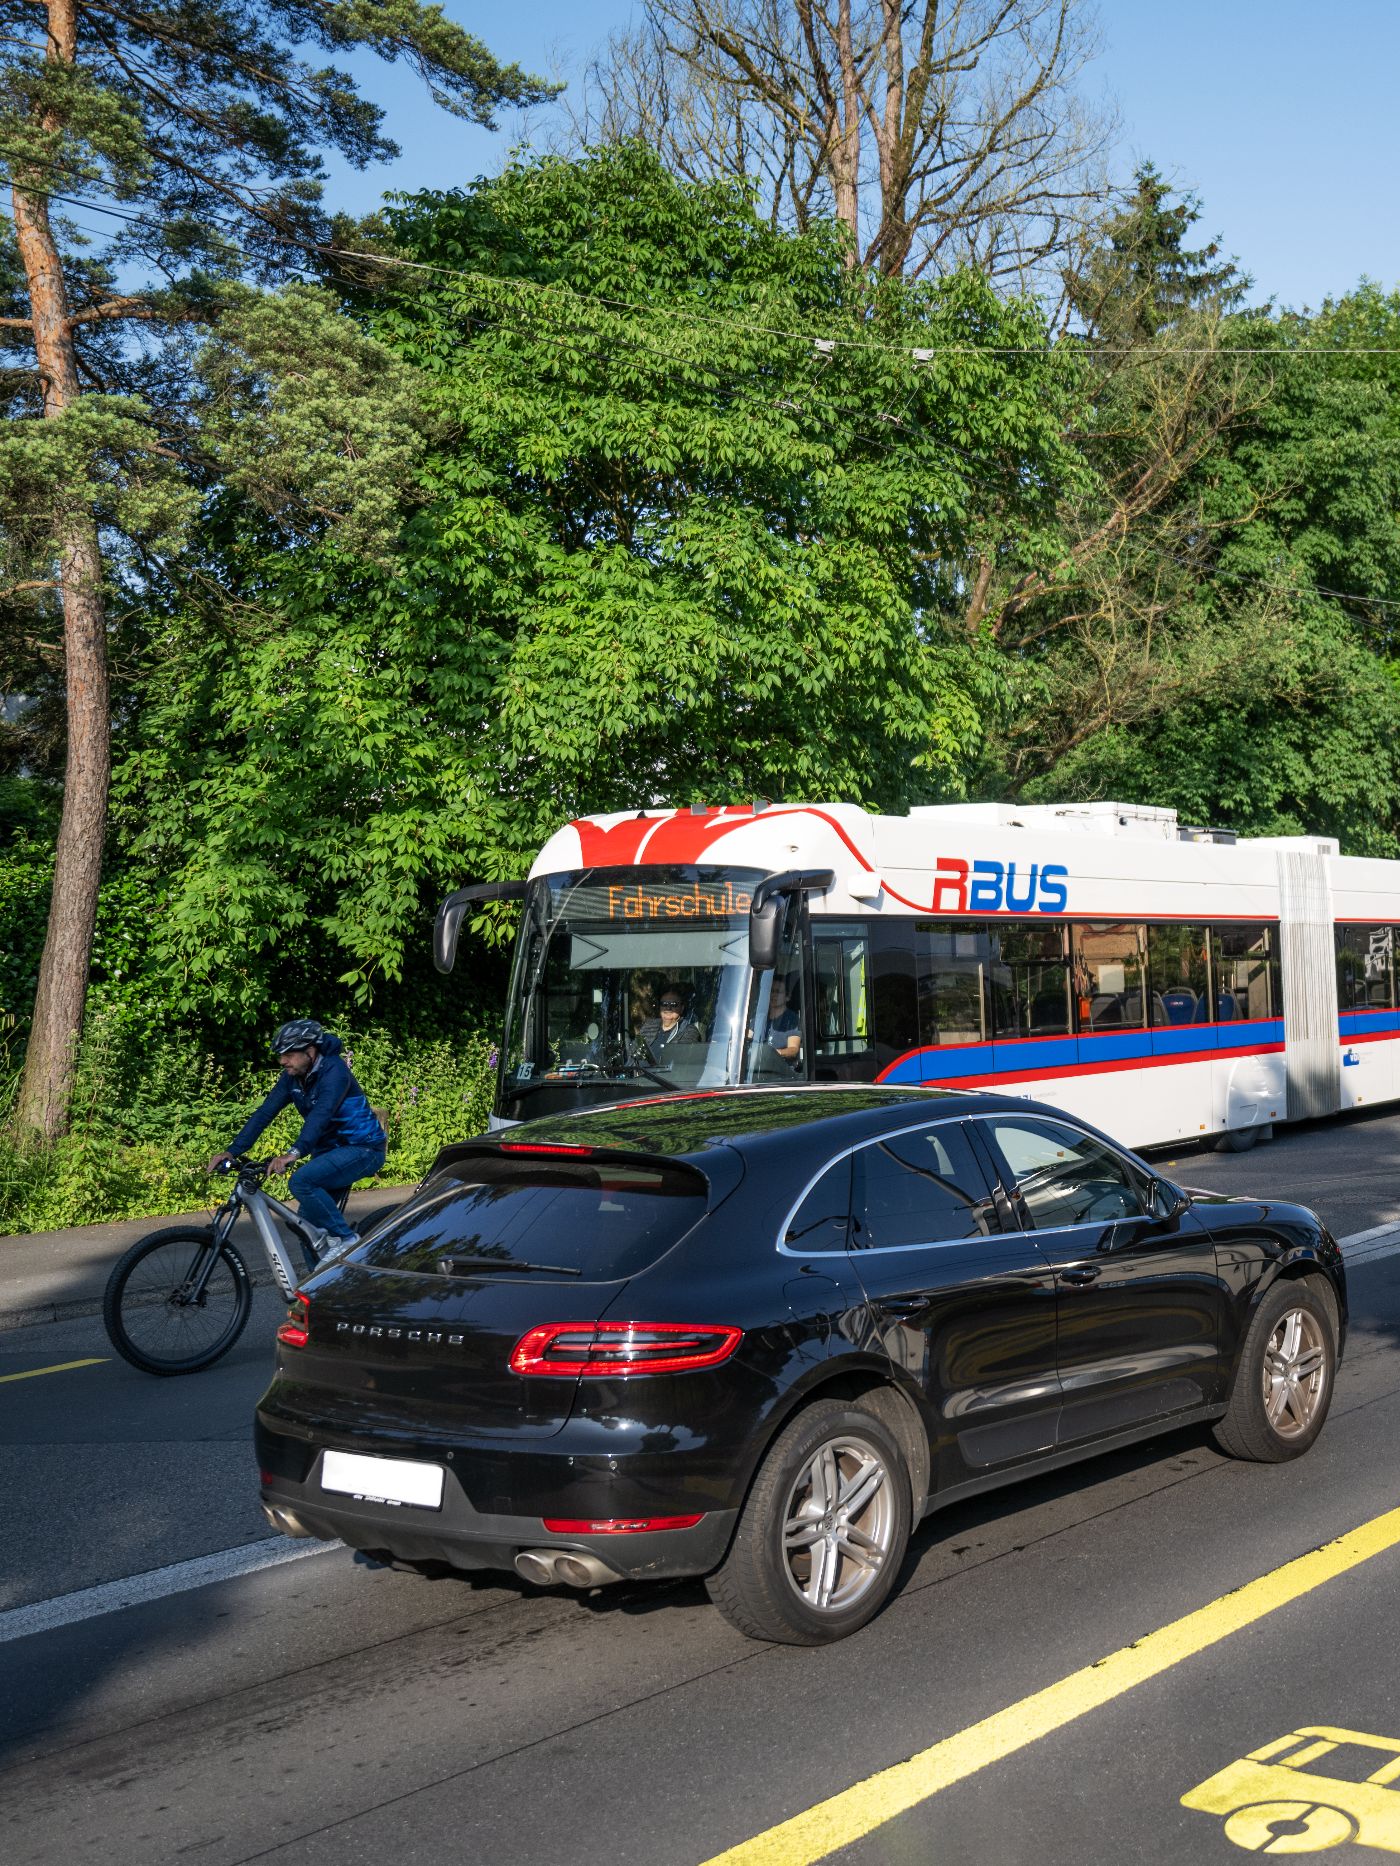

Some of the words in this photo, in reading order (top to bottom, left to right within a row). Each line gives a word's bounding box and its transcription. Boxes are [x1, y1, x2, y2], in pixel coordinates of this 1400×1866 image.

[609, 881, 750, 920] Fahrschule
[932, 857, 1068, 912] RBUS
[519, 1065, 531, 1078] 15
[272, 1252, 292, 1292] SCOTT
[337, 1321, 464, 1344] PORSCHE
